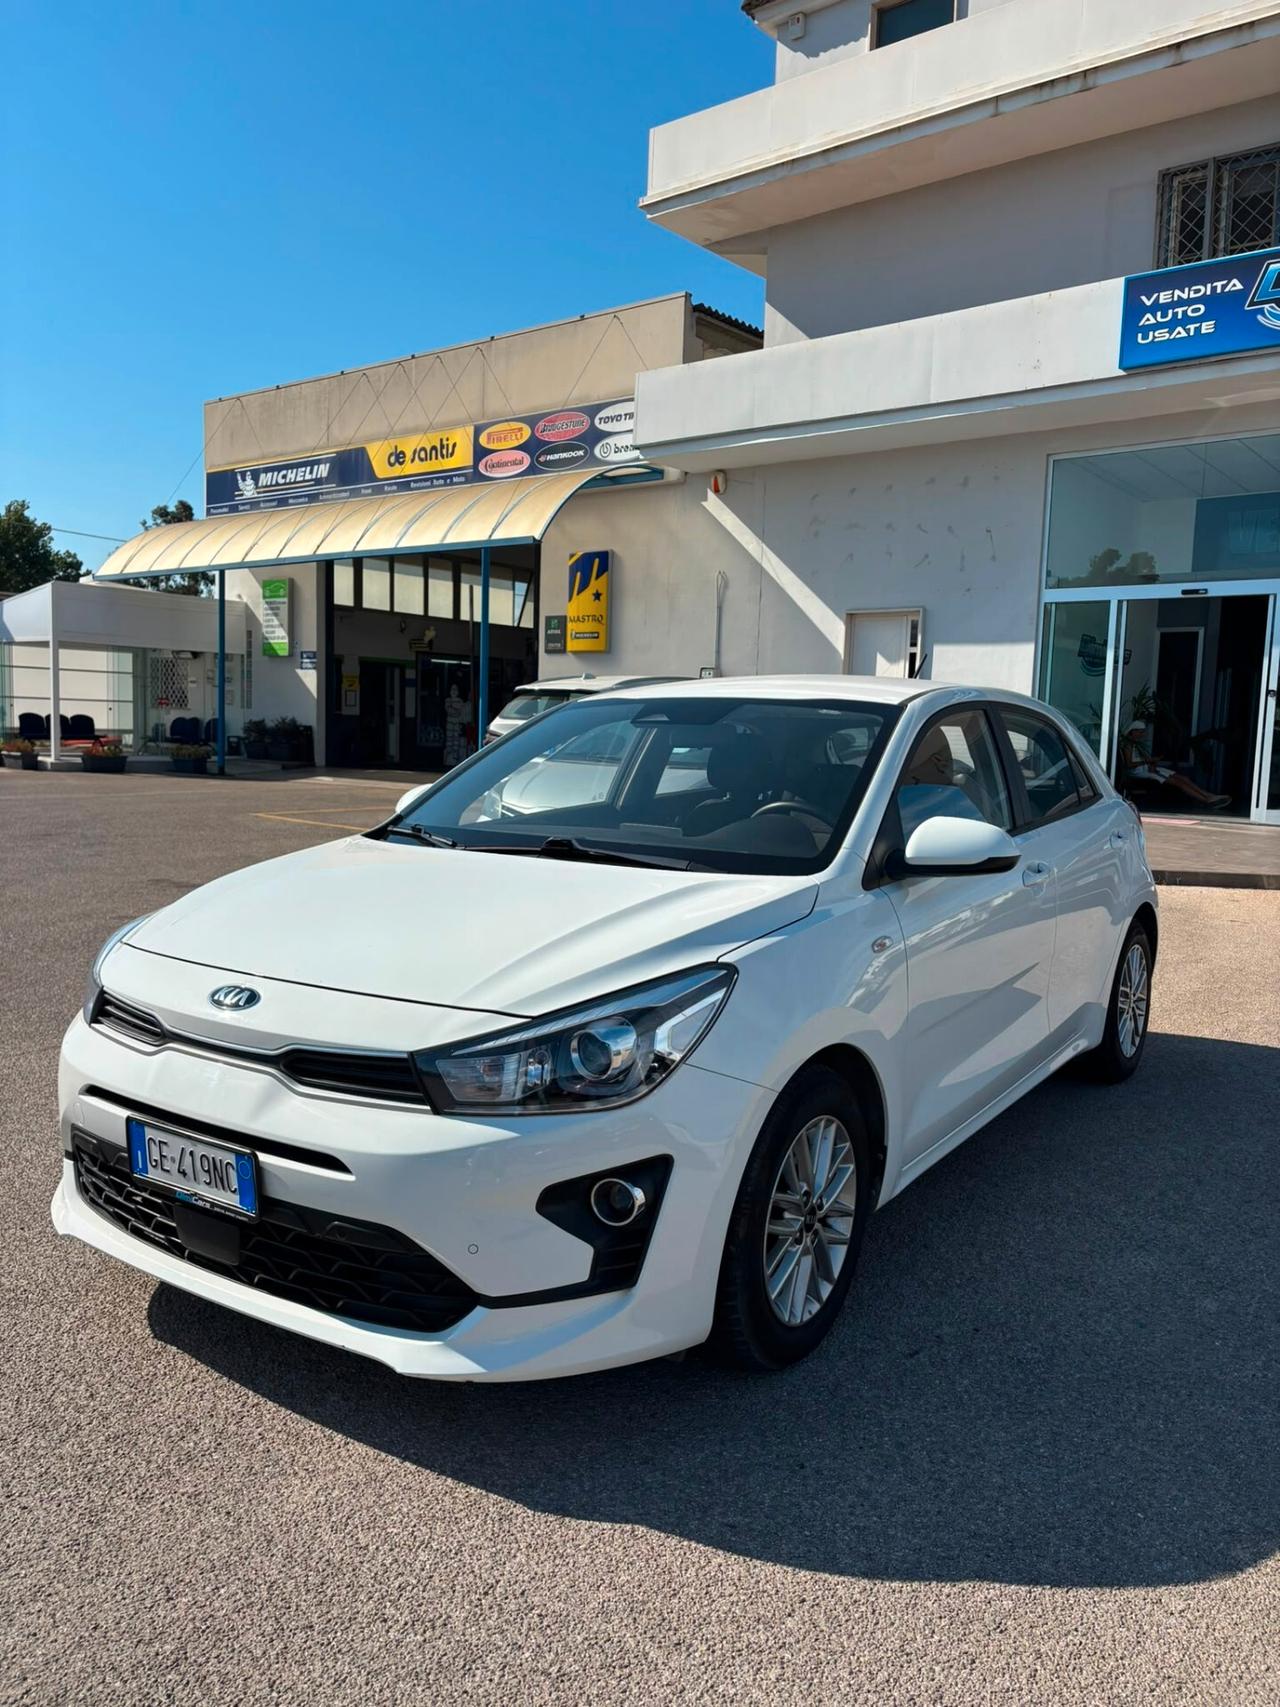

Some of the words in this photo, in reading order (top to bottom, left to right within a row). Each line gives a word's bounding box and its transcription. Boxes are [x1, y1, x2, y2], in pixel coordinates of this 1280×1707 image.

[1140, 278, 1244, 306] VENDITA
[1138, 304, 1206, 327] AUTO
[1137, 320, 1216, 344] USATE
[540, 418, 586, 434] BRIDGESTONE
[598, 413, 623, 425] TOYO
[486, 426, 523, 445] PIRELLI
[387, 445, 406, 467] de
[410, 437, 457, 464] santis
[484, 455, 525, 472] Continental
[258, 462, 331, 487] MICHELIN
[213, 987, 251, 1006] KIA
